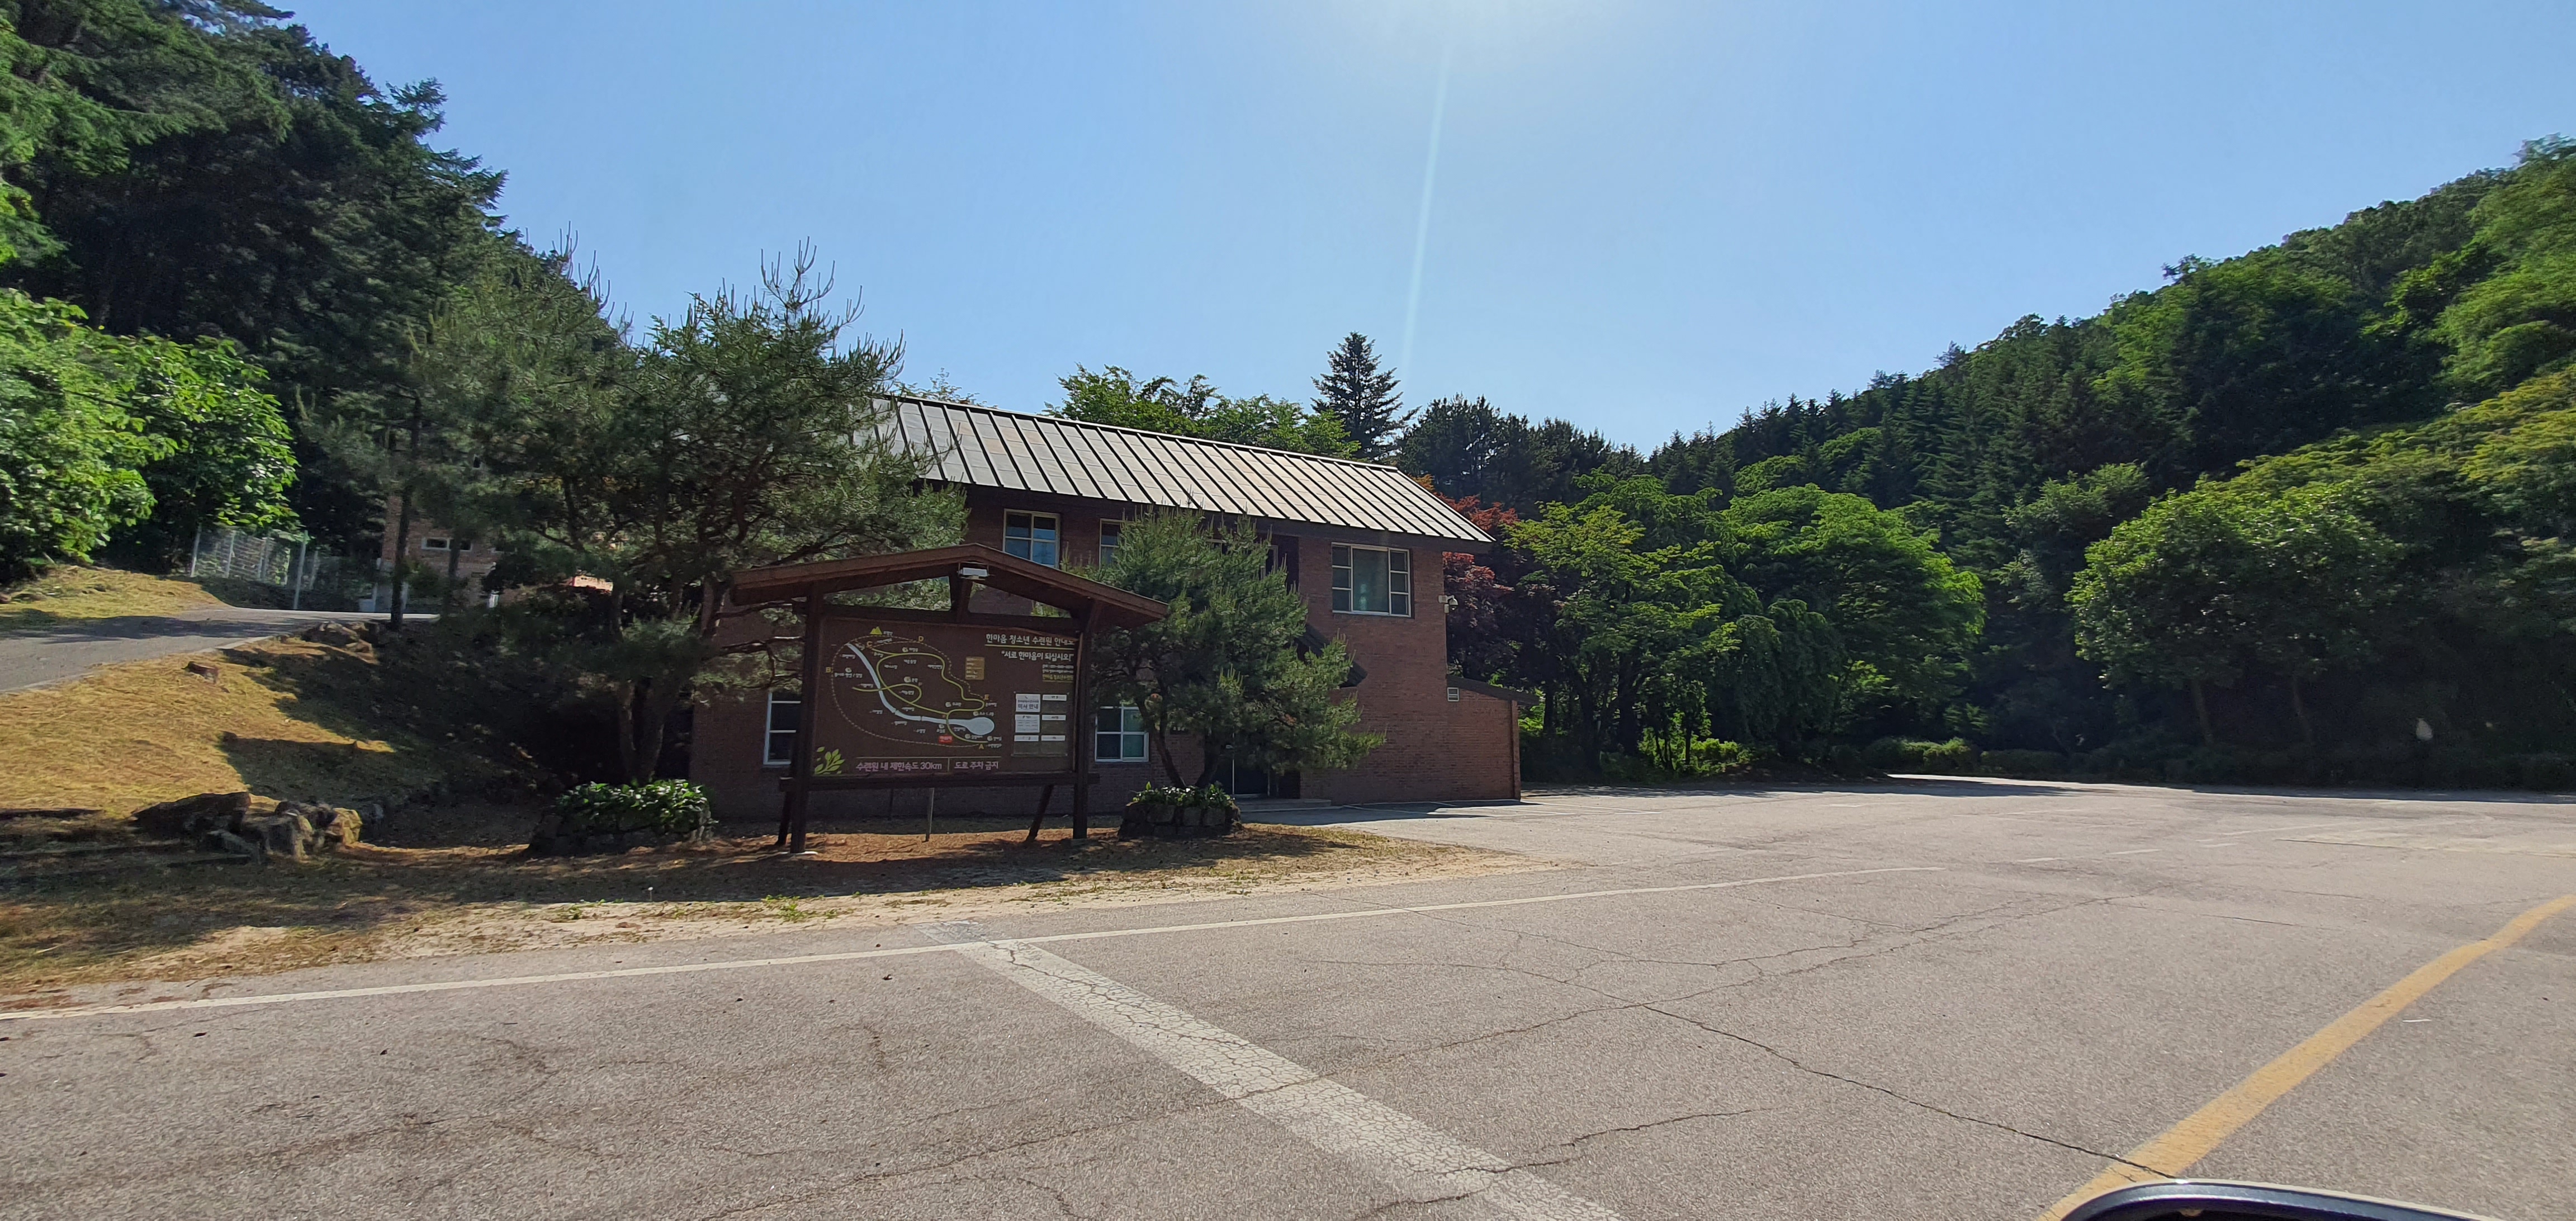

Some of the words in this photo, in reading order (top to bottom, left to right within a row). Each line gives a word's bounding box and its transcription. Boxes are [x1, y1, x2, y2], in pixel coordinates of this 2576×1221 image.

[986, 633, 1007, 643] 한마음
[1009, 635, 1030, 645] 청소년
[1032, 636, 1052, 646] 수련원
[1019, 651, 1043, 660] 한마음이
[855, 762, 879, 772] 수련원
[880, 762, 888, 770] 내
[890, 762, 919, 772] 제한속도
[985, 761, 999, 770] 금지
